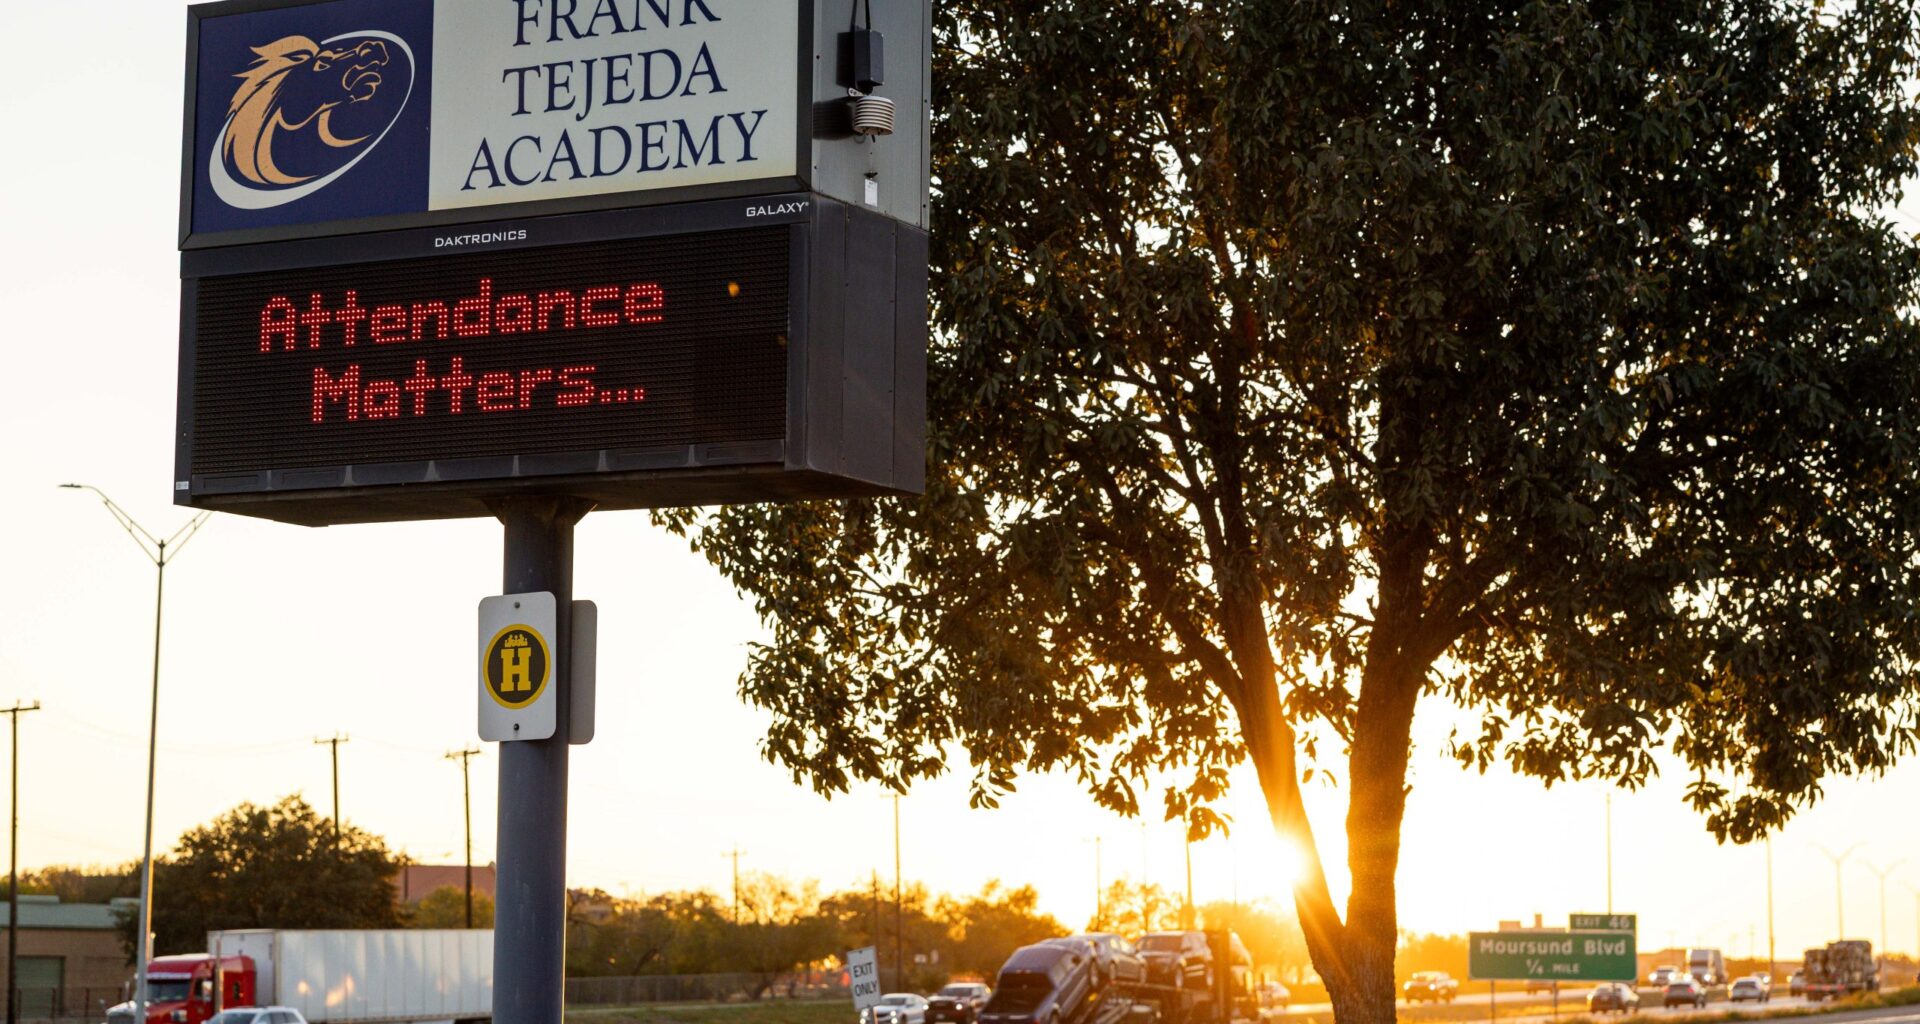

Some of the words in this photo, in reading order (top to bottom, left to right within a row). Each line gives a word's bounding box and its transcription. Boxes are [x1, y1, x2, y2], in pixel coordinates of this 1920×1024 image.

[502, 41, 728, 121] TEJEDA
[461, 109, 768, 191] ACADEMY
[434, 229, 527, 248] DAKTRONICS
[261, 278, 664, 353] Attendance
[312, 356, 646, 422] Matters...
[500, 647, 531, 692] H
[1575, 916, 1601, 928] EXIT
[1608, 915, 1631, 929] 46
[1479, 938, 1573, 956] Moursund
[1584, 938, 1627, 956] Blvd
[853, 962, 873, 978] EXIT
[1552, 962, 1580, 975] MILE
[854, 980, 878, 997] ONLY
